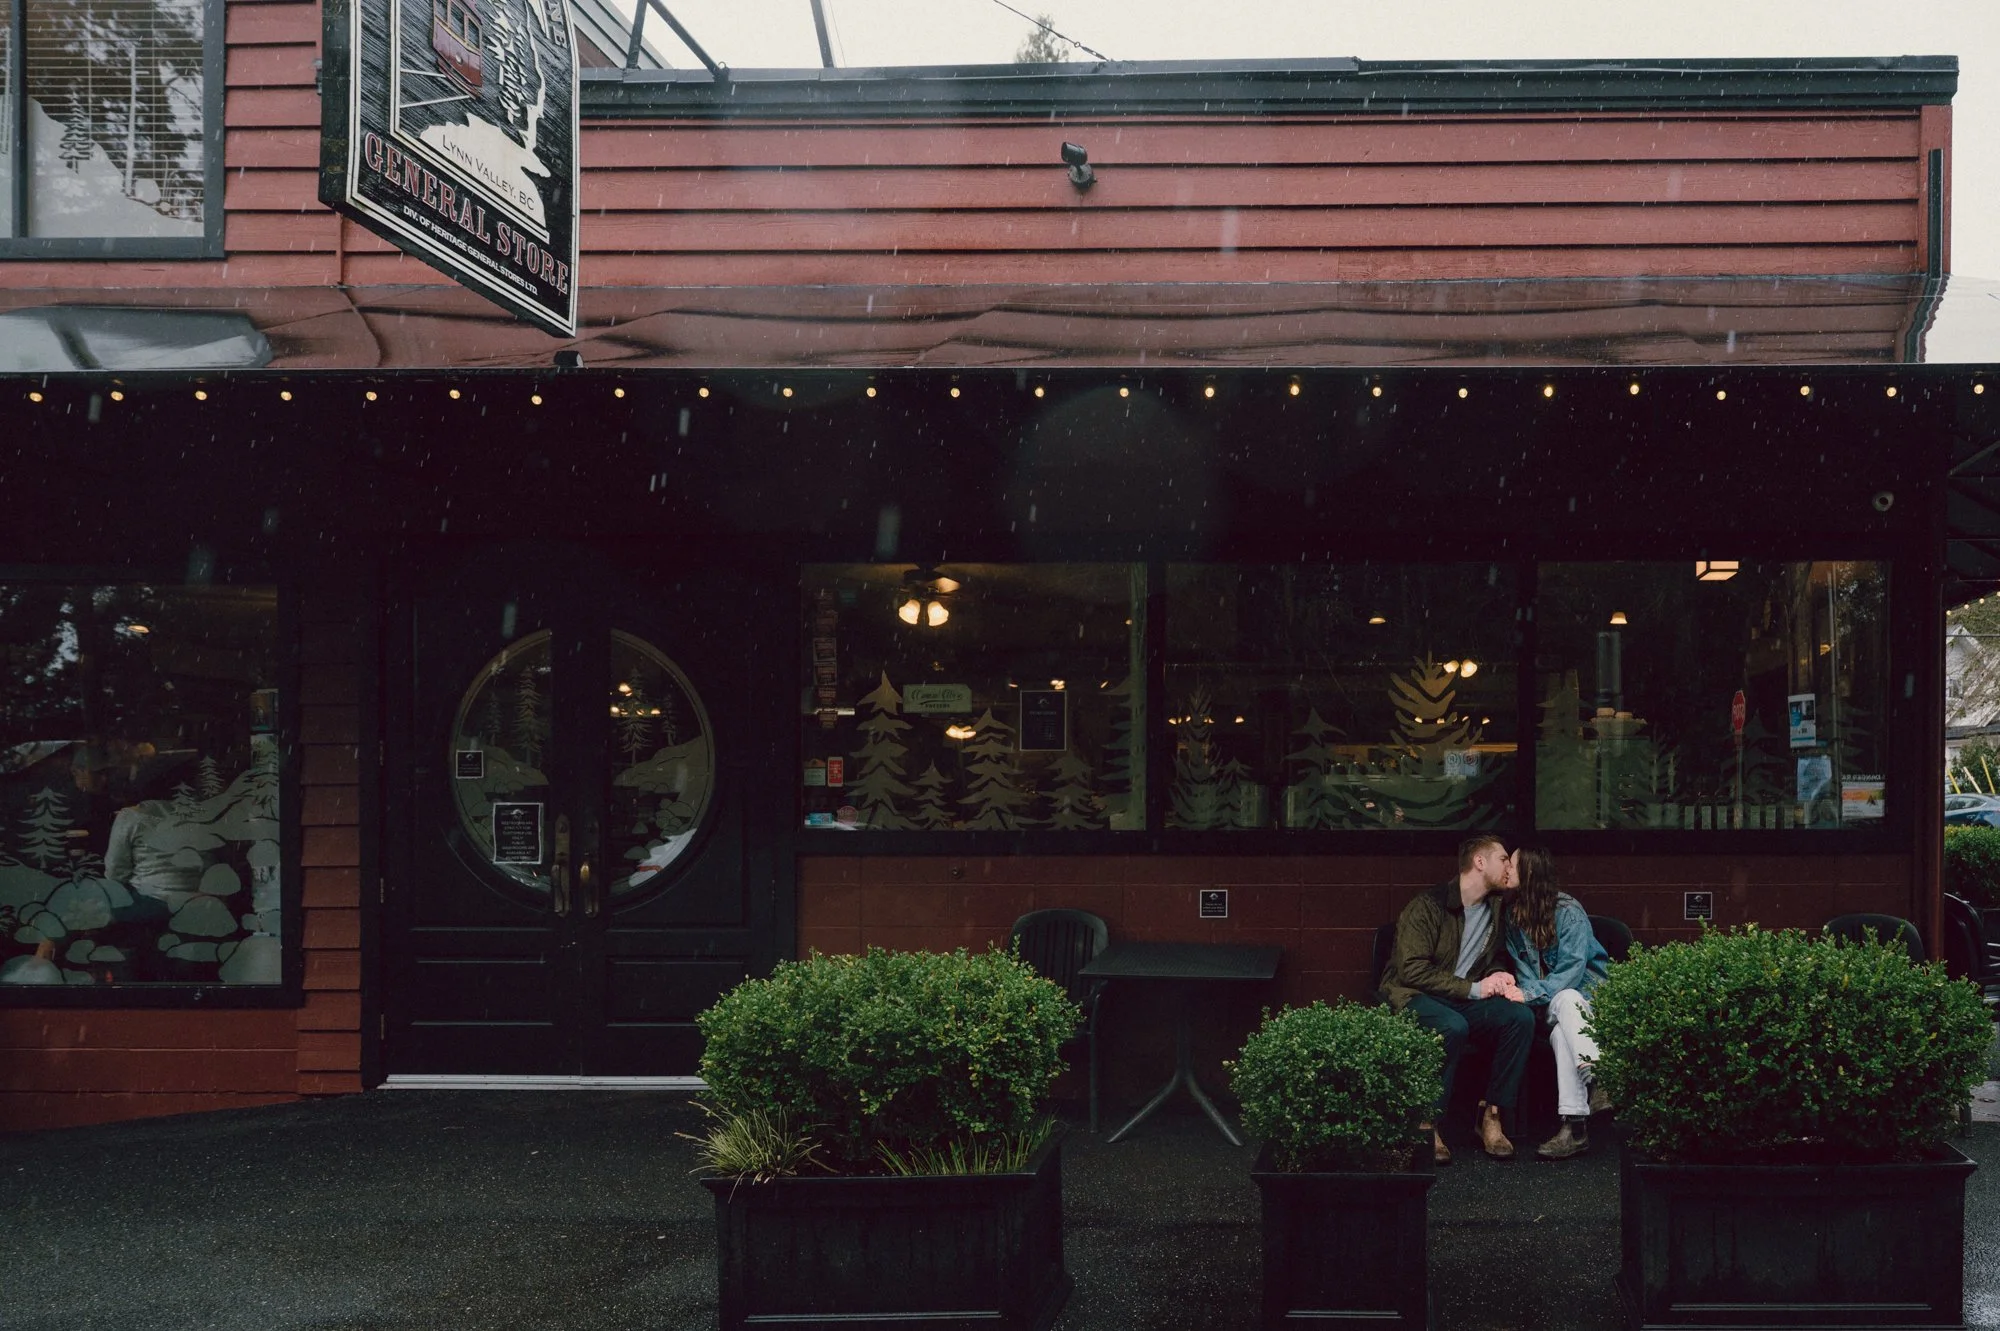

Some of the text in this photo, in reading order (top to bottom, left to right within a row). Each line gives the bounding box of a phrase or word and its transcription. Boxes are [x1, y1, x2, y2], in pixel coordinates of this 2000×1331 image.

[365, 132, 569, 295] GENERAL STORE
[443, 134, 472, 167] LYNN
[519, 190, 534, 211] BC
[403, 205, 418, 221] DIV.
[419, 214, 432, 227] OF
[431, 222, 468, 252] HERITAGE
[467, 245, 500, 271] GENERAL
[499, 265, 525, 288] STORES
